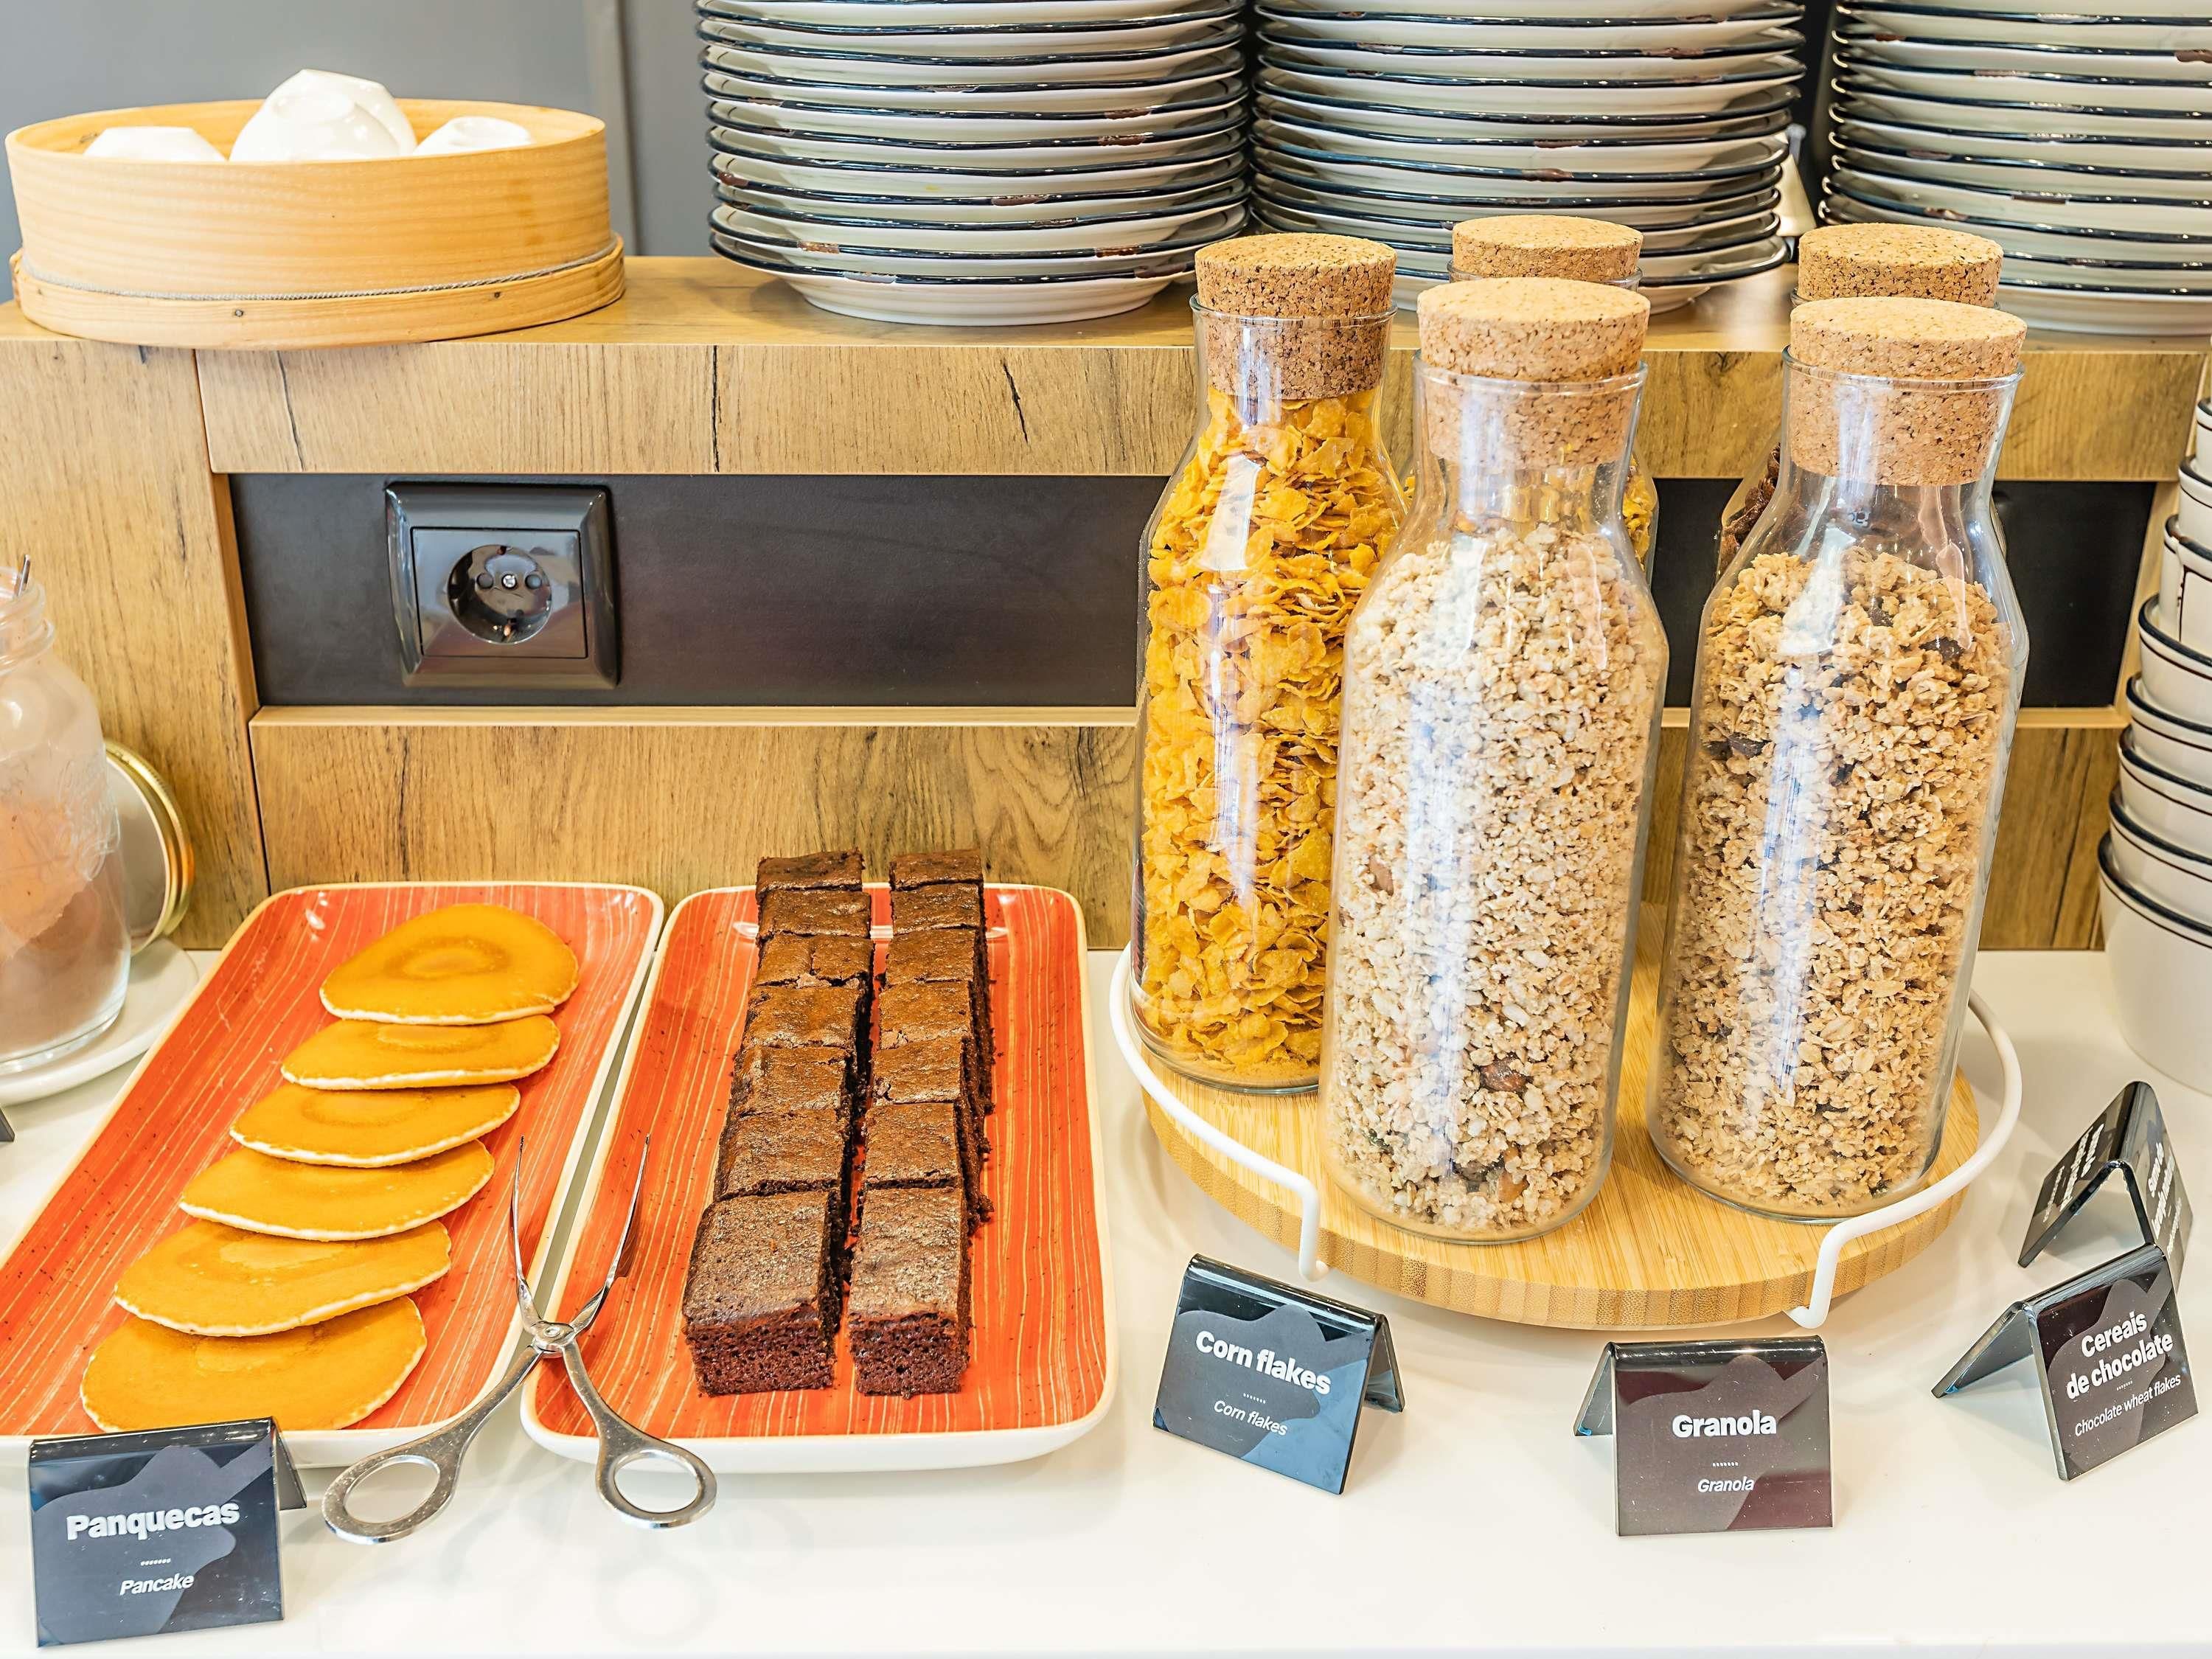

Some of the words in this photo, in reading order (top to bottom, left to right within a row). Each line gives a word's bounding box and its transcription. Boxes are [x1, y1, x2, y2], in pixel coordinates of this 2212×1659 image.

[2081, 1310, 2147, 1357] Cereais
[1195, 1330, 1253, 1368] Corn
[1256, 1349, 1332, 1395] flakes
[2067, 1372, 2090, 1399] de
[2090, 1333, 2174, 1388] chocolate
[1214, 1400, 1247, 1423] Corn
[1247, 1410, 1288, 1436] flakes
[1672, 1409, 1778, 1438] Granola
[2075, 1404, 2123, 1437] Chocolate
[2123, 1387, 2154, 1412] wheat
[2153, 1374, 2182, 1397] flakes
[1697, 1476, 1755, 1492] Granola
[66, 1503, 240, 1540] Panquecas
[119, 1573, 195, 1595] Pancake
